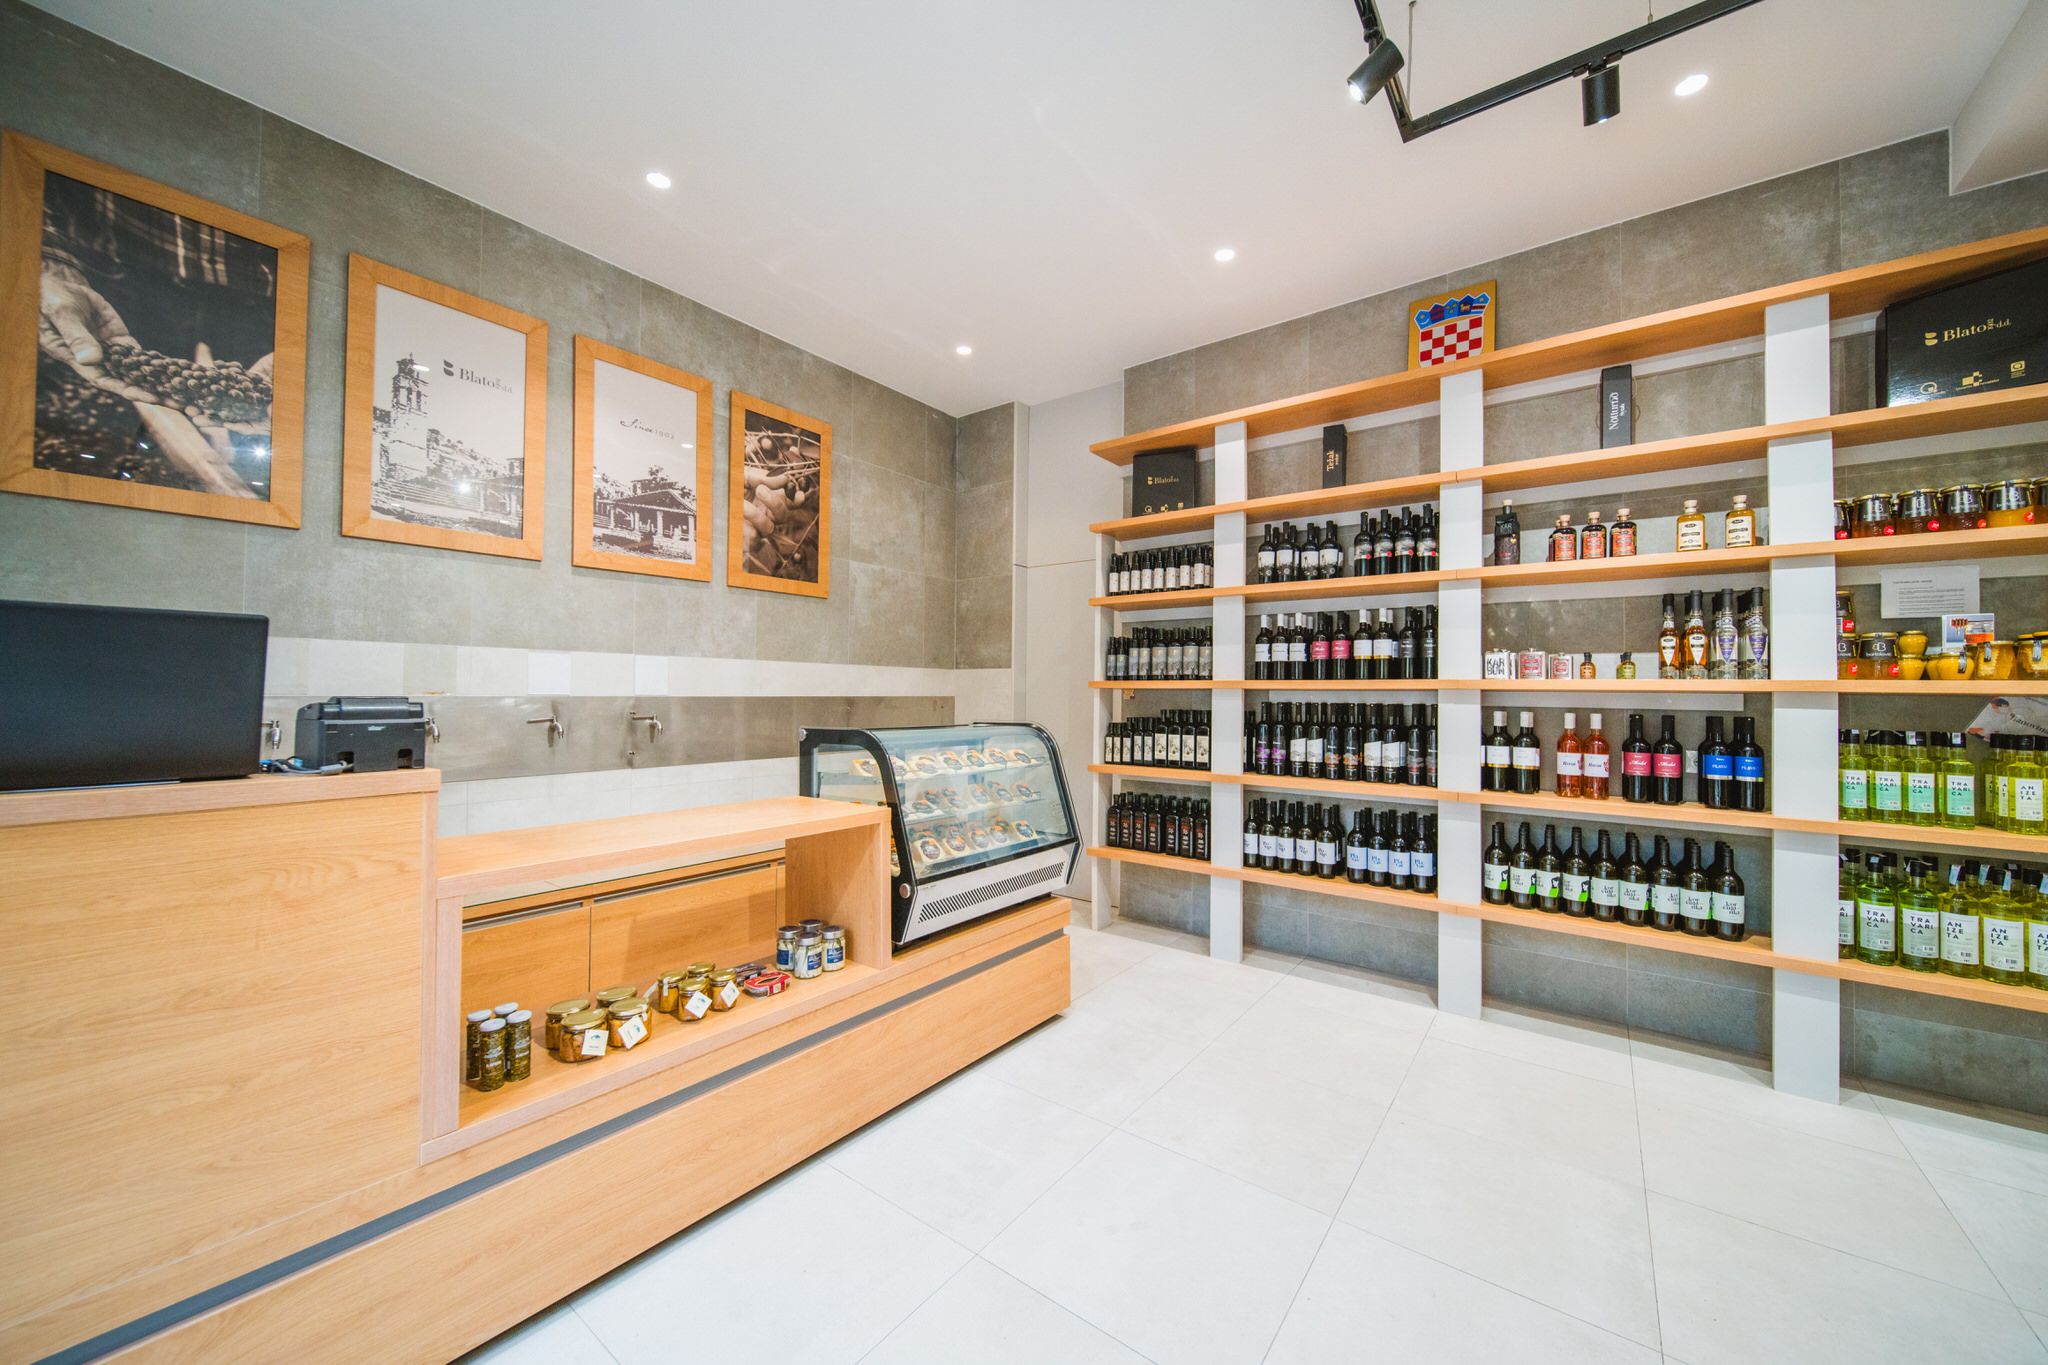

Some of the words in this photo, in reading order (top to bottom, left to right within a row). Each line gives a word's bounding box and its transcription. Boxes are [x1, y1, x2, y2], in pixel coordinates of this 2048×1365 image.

[1943, 324, 1986, 342] Blato
[459, 368, 495, 388] Blato
[1487, 658, 1504, 667] KAR
[1866, 916, 1889, 924] VARI
[1910, 916, 1931, 924] TRA
[1910, 922, 1934, 930] VARI
[1990, 933, 2009, 941] IZE
